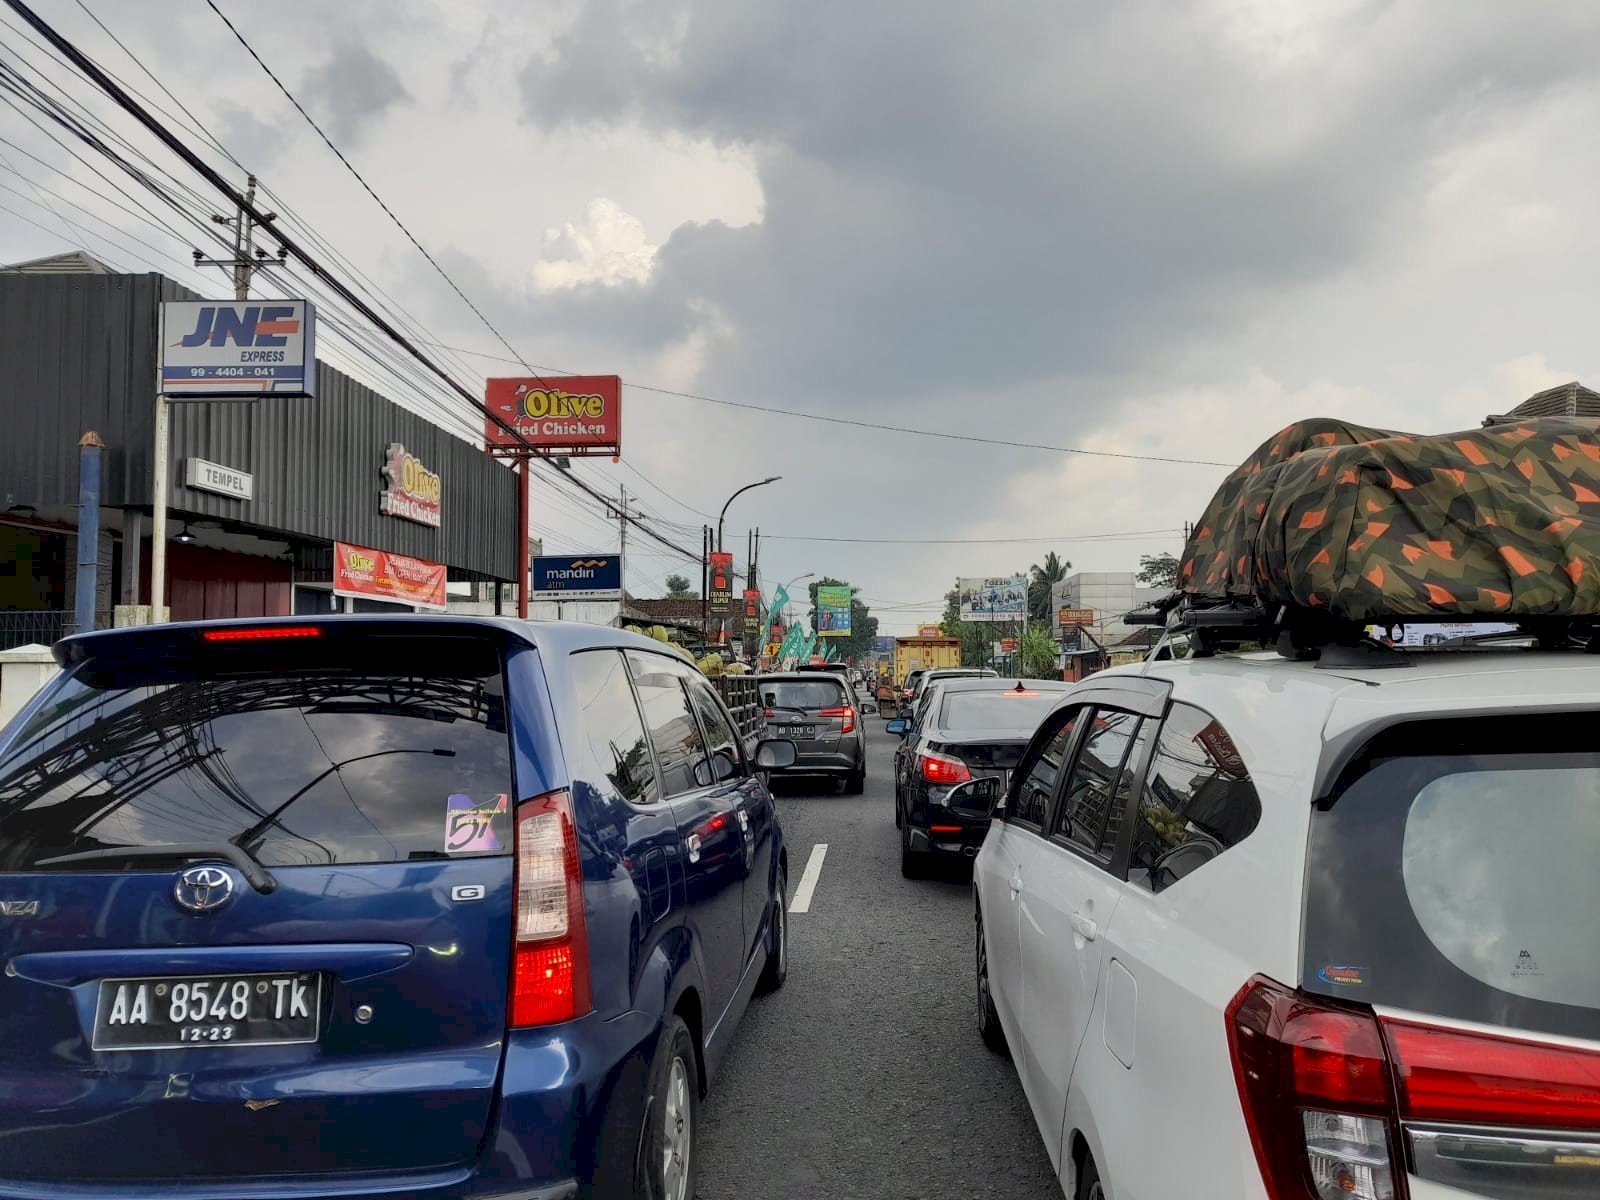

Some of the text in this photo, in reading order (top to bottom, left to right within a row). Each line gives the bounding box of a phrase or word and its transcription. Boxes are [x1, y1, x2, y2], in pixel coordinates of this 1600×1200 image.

[181, 306, 299, 348] JNE
[240, 351, 285, 362] EXPRESS
[190, 367, 205, 377] 99
[215, 367, 244, 376] 4404
[254, 367, 275, 376] 041
[525, 389, 603, 419] Olive
[542, 422, 606, 435] Chicken
[206, 468, 244, 491] TEMPEL
[403, 454, 440, 504] Olive
[388, 493, 440, 527] Fried Chicken
[546, 566, 594, 579] mandiri
[456, 887, 480, 899] G
[108, 977, 309, 1025] AA 8548 TK
